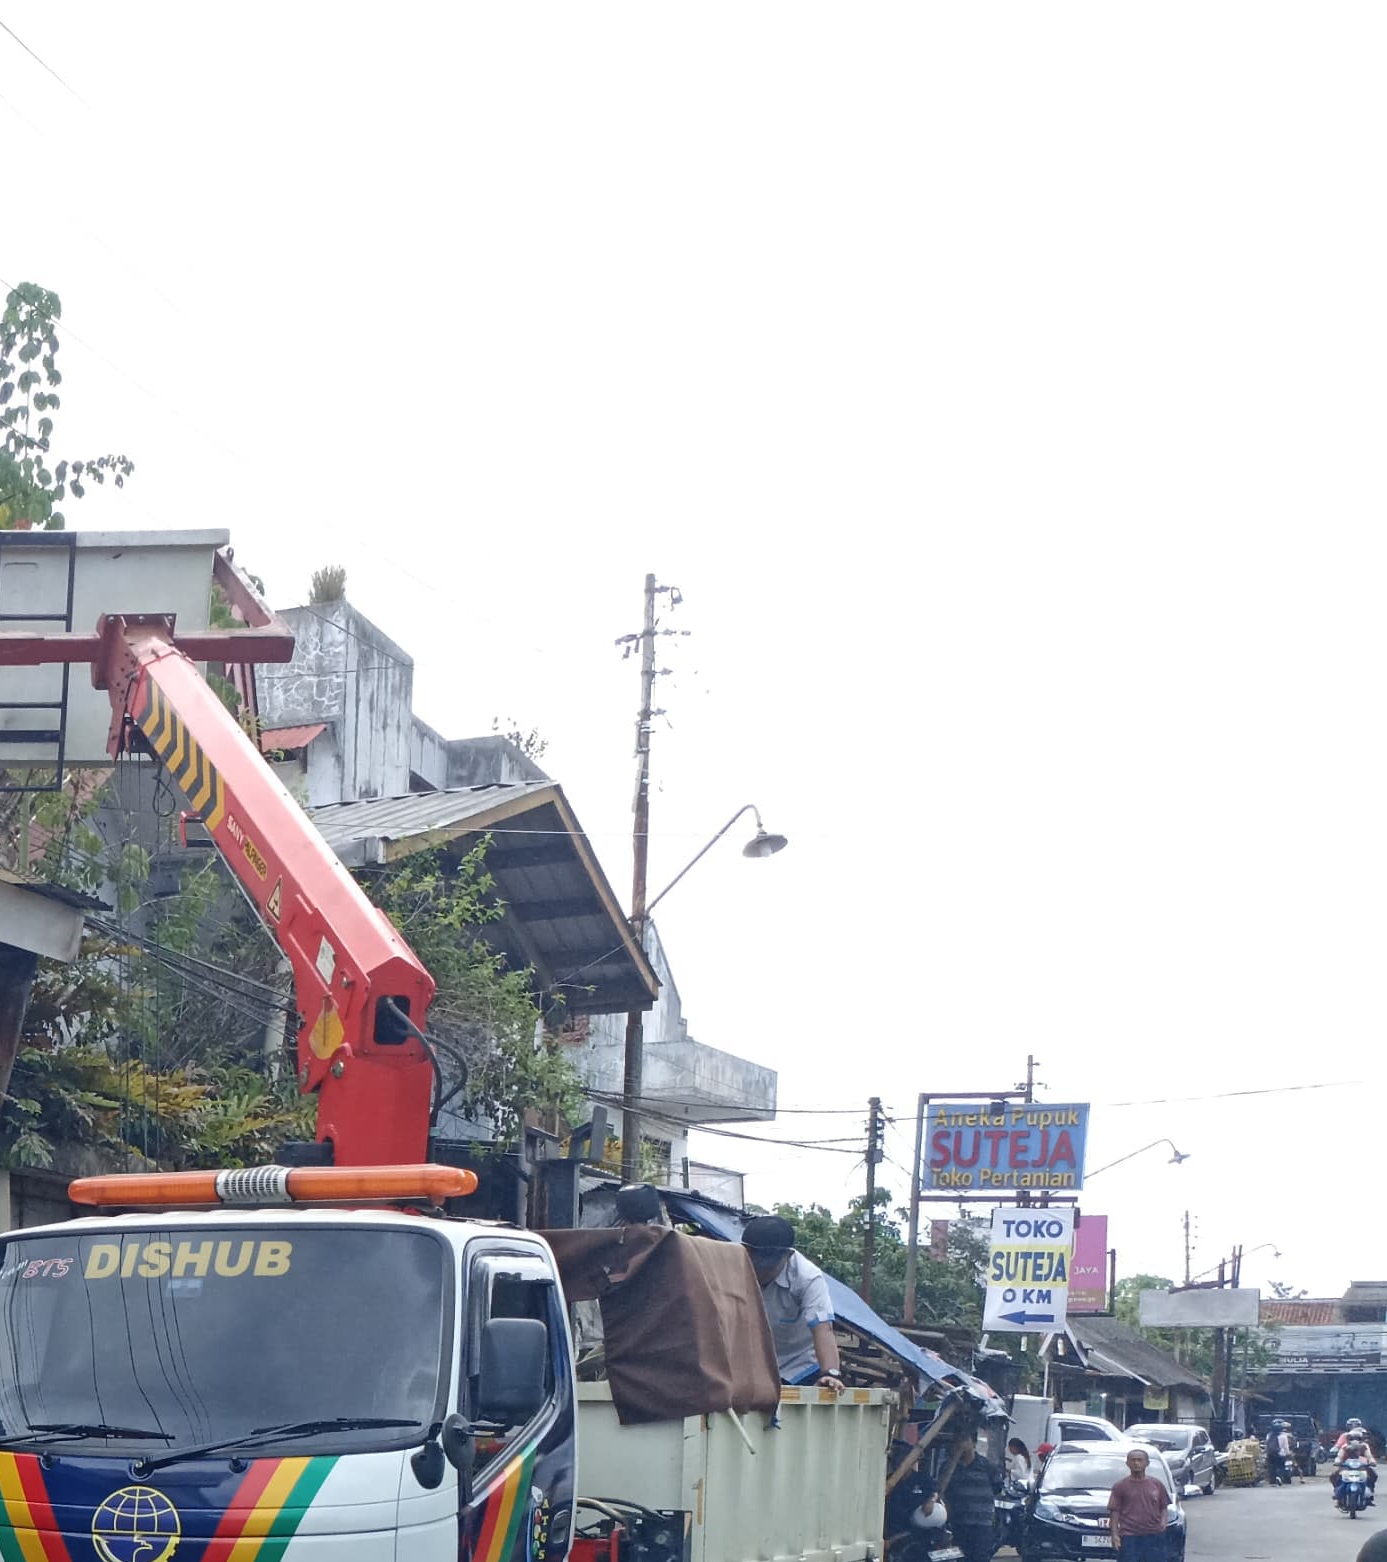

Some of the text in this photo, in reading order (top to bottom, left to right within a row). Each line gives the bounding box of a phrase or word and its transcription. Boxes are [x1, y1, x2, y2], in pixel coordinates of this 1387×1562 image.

[934, 1106, 1080, 1130] Aneka Pupuk
[930, 1130, 1077, 1168] SUTEJA
[932, 1168, 1075, 1187] Toko Pertanian
[1003, 1220, 1064, 1239] TOKO
[22, 1257, 74, 1279] BTS
[83, 1240, 294, 1280] DISHUB
[991, 1251, 1067, 1282] SUTEJA
[1074, 1266, 1099, 1275] JAYA
[1022, 1289, 1052, 1304] KM
